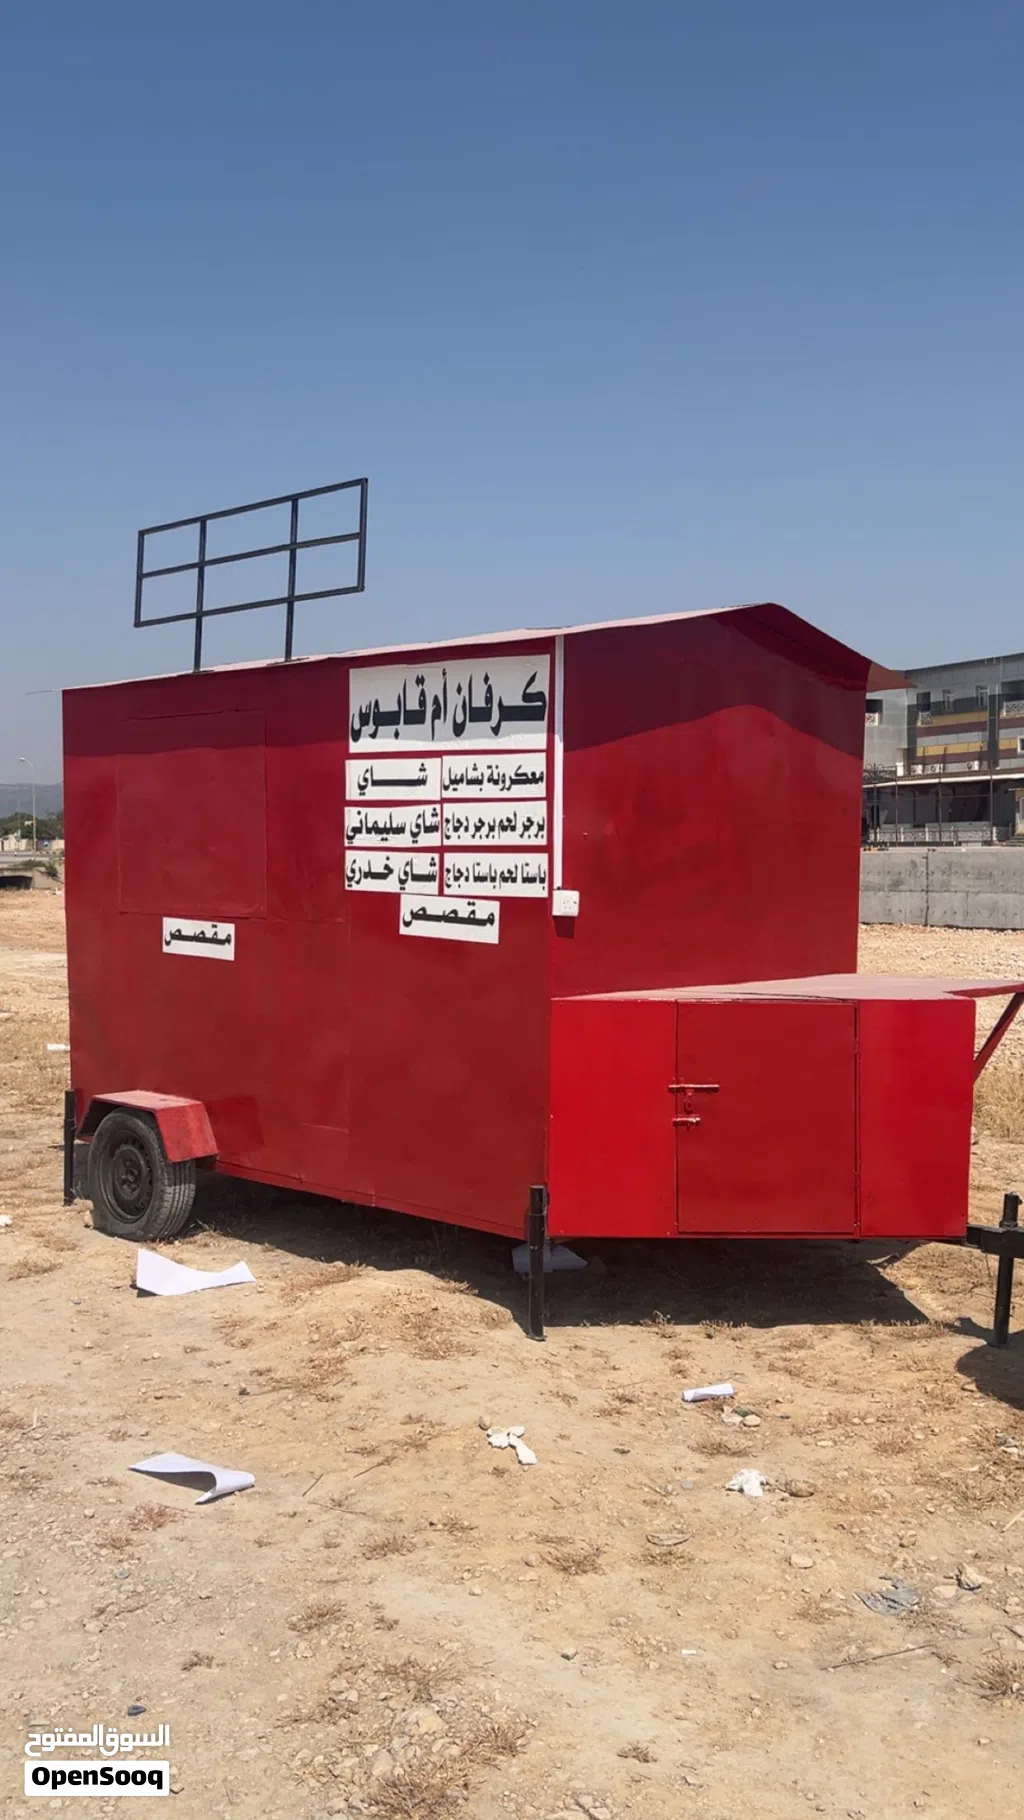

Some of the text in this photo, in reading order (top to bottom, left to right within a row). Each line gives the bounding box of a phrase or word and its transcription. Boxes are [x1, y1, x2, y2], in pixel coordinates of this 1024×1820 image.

[351, 668, 547, 743] كرفان أم قابوس
[357, 762, 428, 796] شاي
[443, 763, 545, 792] معكرونة بشاميل
[346, 807, 440, 844] شاي سليماني
[444, 811, 545, 840] برجر لحم برجر دجاج
[346, 856, 437, 890] شاي خدري
[445, 862, 546, 890] باستا لحم باستا دجاج
[402, 901, 495, 928] مقصص
[164, 924, 231, 946] مقصص
